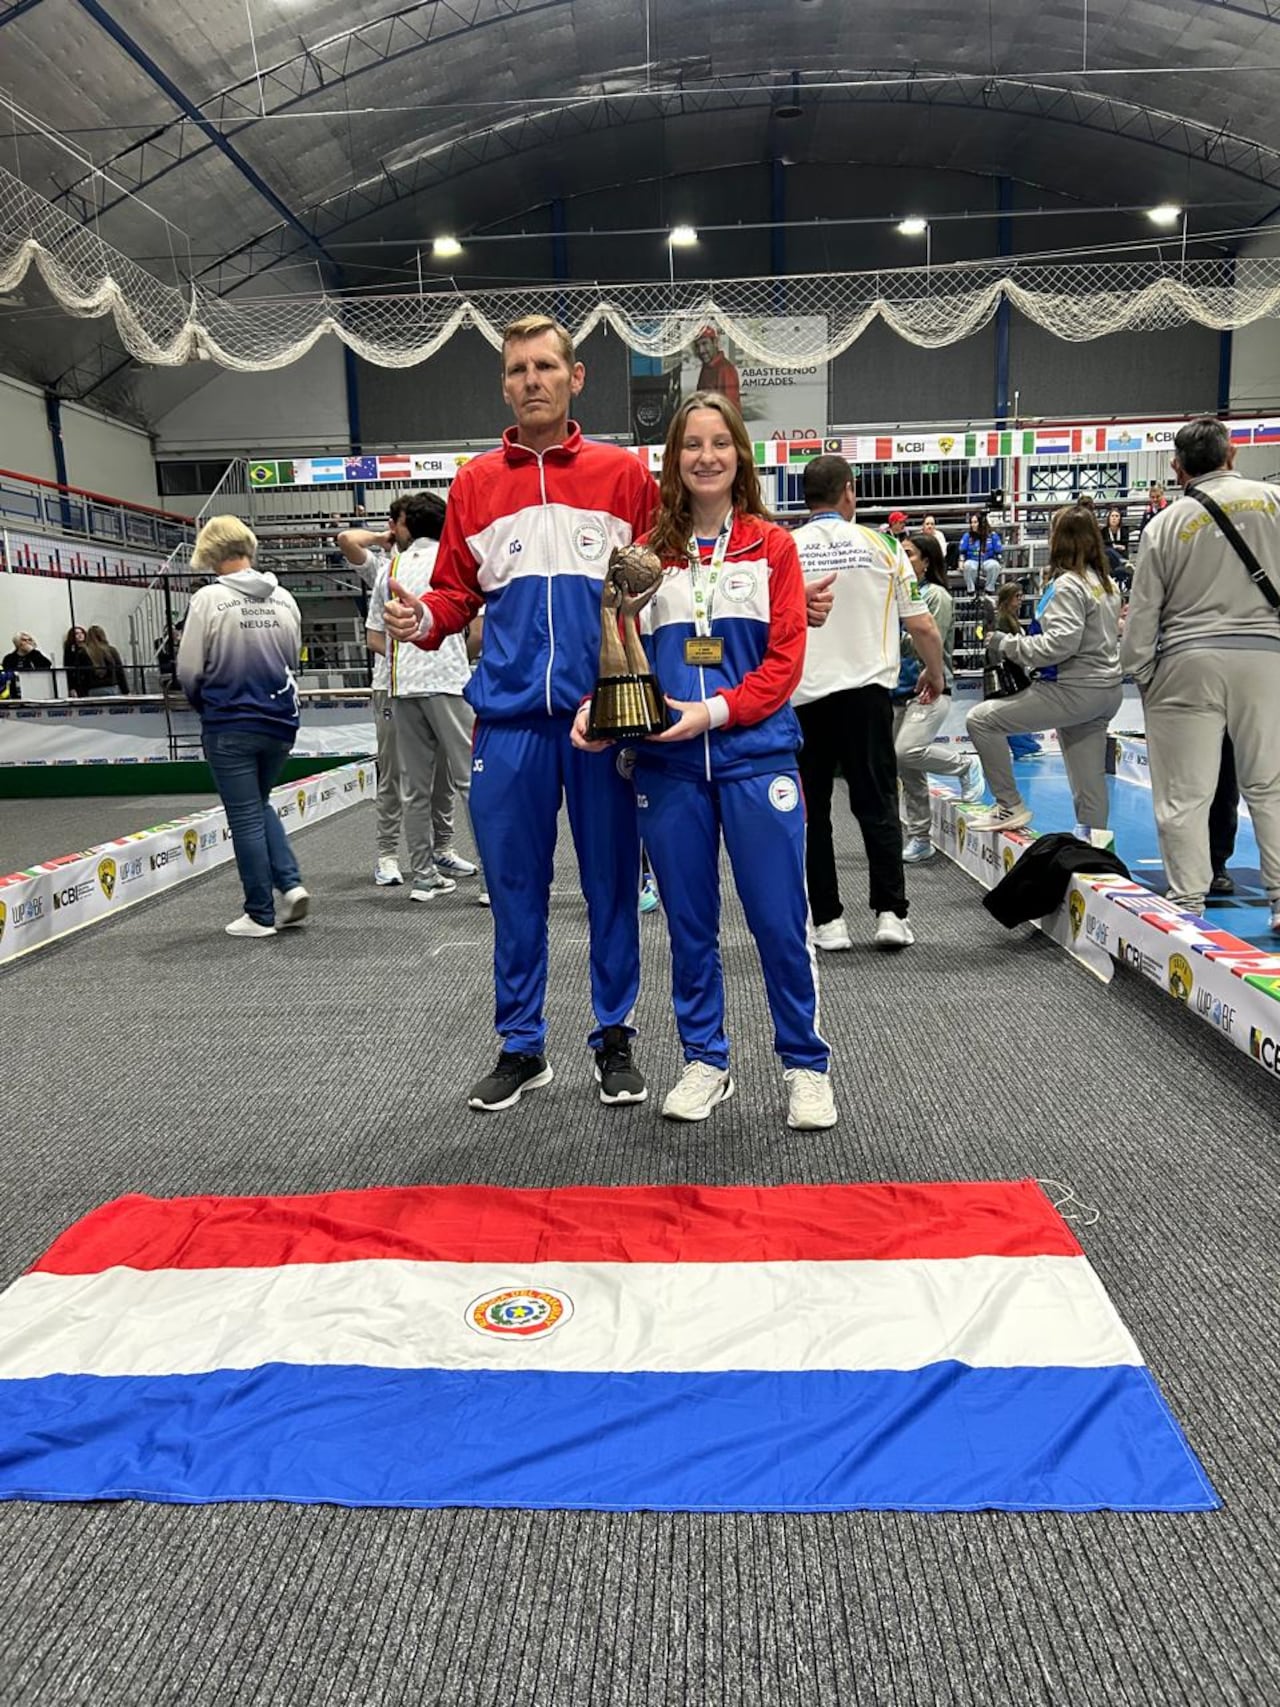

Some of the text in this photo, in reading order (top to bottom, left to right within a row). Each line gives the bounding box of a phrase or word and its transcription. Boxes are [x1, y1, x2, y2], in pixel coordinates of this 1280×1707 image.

[742, 366, 817, 377] ABASTECENDO
[742, 377, 796, 387] AMIZADES.
[905, 442, 925, 453] CBI
[422, 460, 443, 471] CBI
[217, 599, 240, 612] Club
[241, 607, 276, 616] Bochas
[240, 620, 280, 629] NEUSA
[60, 885, 79, 906] CBI
